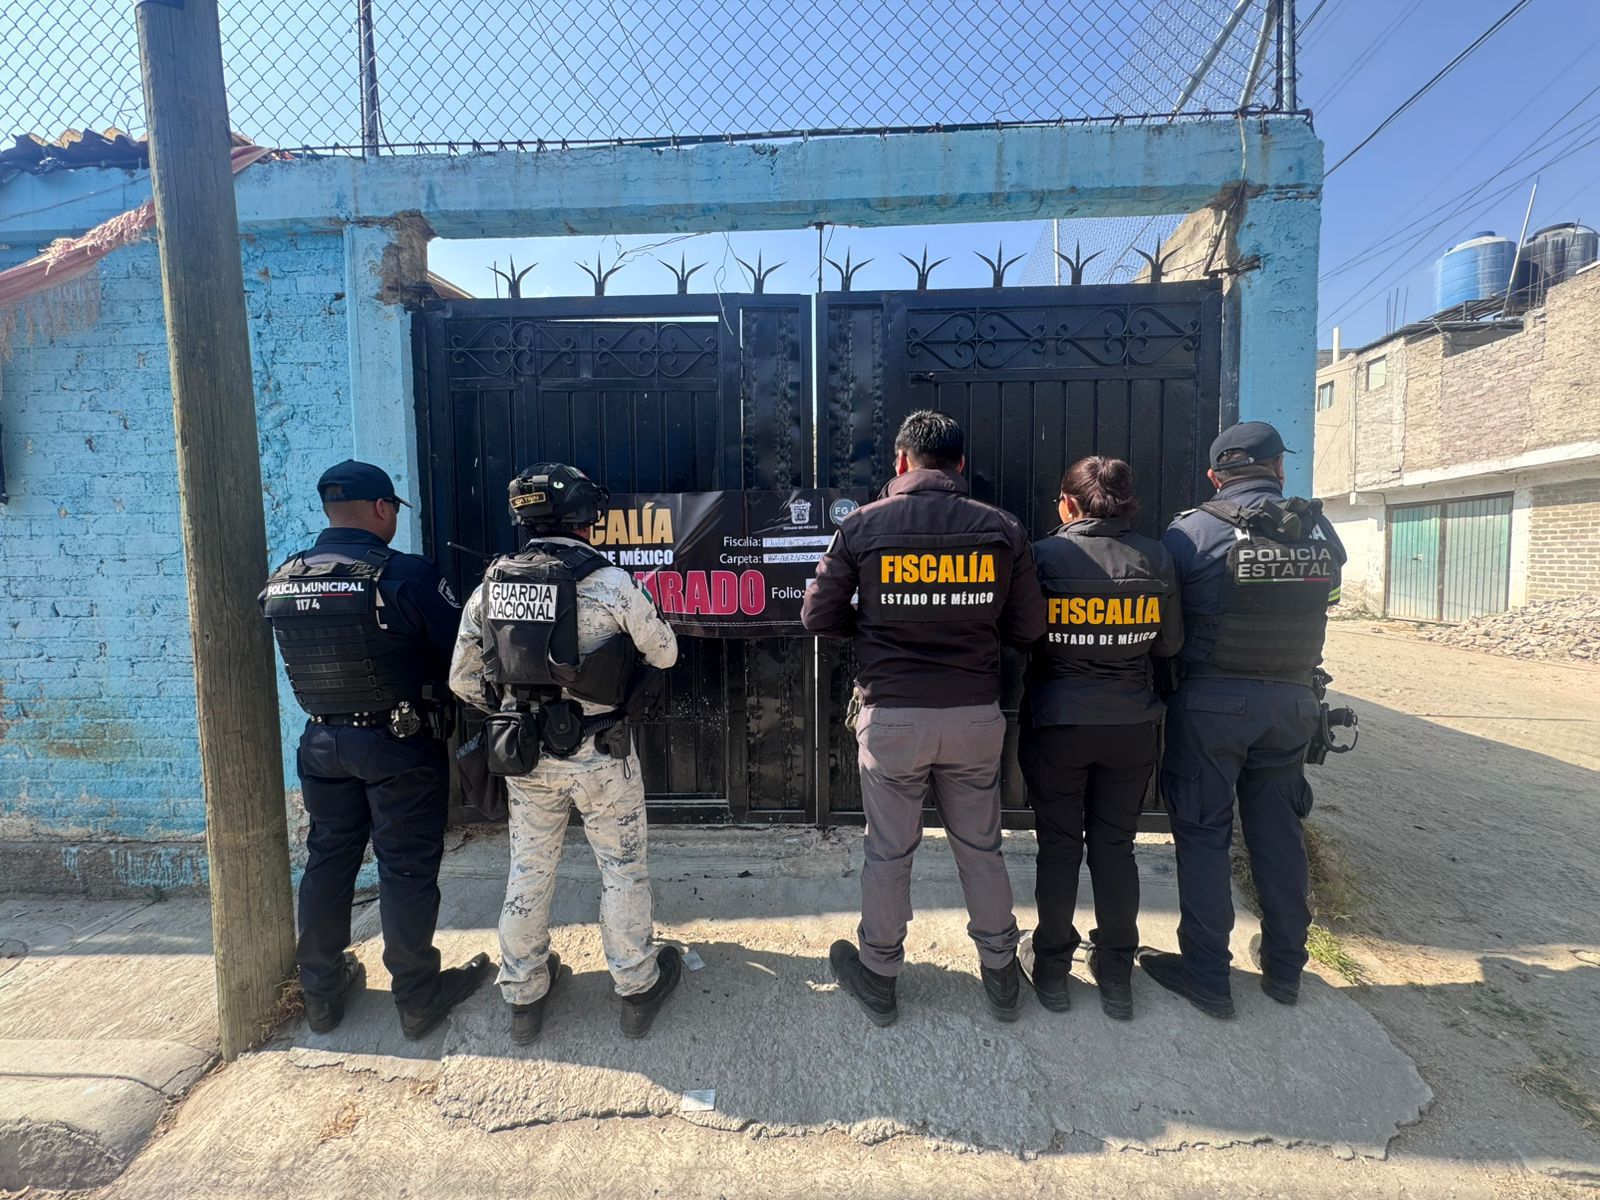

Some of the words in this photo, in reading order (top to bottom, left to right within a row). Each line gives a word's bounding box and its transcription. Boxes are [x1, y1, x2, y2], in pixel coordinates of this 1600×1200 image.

[723, 536, 761, 547] Fiscalía:
[620, 547, 674, 566] MÉXICO
[719, 553, 762, 566] Carpeta:
[1238, 545, 1332, 563] POLICÍA
[881, 551, 995, 584] FISCALÍA
[1237, 562, 1331, 578] ESTATAL
[301, 581, 364, 593] MUNICIPAL
[492, 583, 553, 604] GUARDIA
[771, 586, 806, 599] Folio:
[295, 598, 320, 611] 1174
[881, 593, 928, 605] ESTADO
[932, 593, 947, 605] DE
[951, 591, 994, 605] MÉXICO
[488, 601, 554, 621] NACIONAL
[1048, 594, 1161, 625] FISCALÍA
[1048, 632, 1095, 645] ESTADO
[1099, 634, 1113, 645] DE
[1118, 631, 1158, 645] MÉXICO
